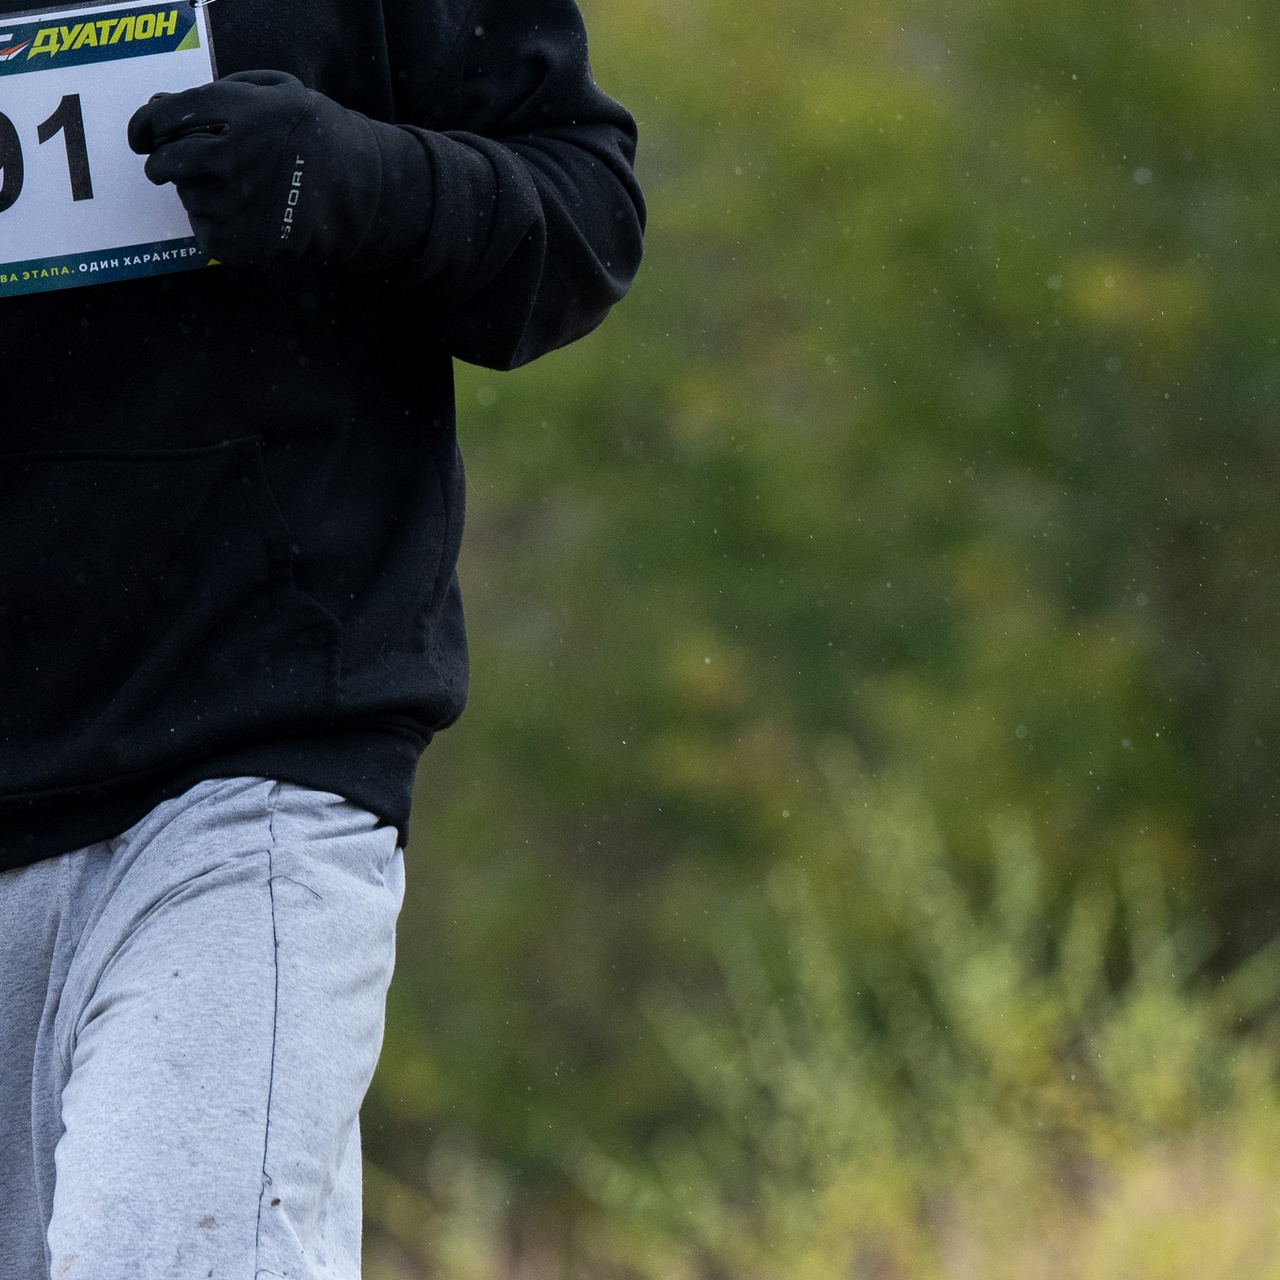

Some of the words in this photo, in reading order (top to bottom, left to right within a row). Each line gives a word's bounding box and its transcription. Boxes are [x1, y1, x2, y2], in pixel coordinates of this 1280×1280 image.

[26, 9, 178, 61] ДУАТЛОН
[280, 154, 305, 239] SPORT
[22, 266, 75, 281] ЭТАПА.
[78, 258, 120, 273] ОДИН
[123, 247, 203, 267] ХАРАКТЕР.
